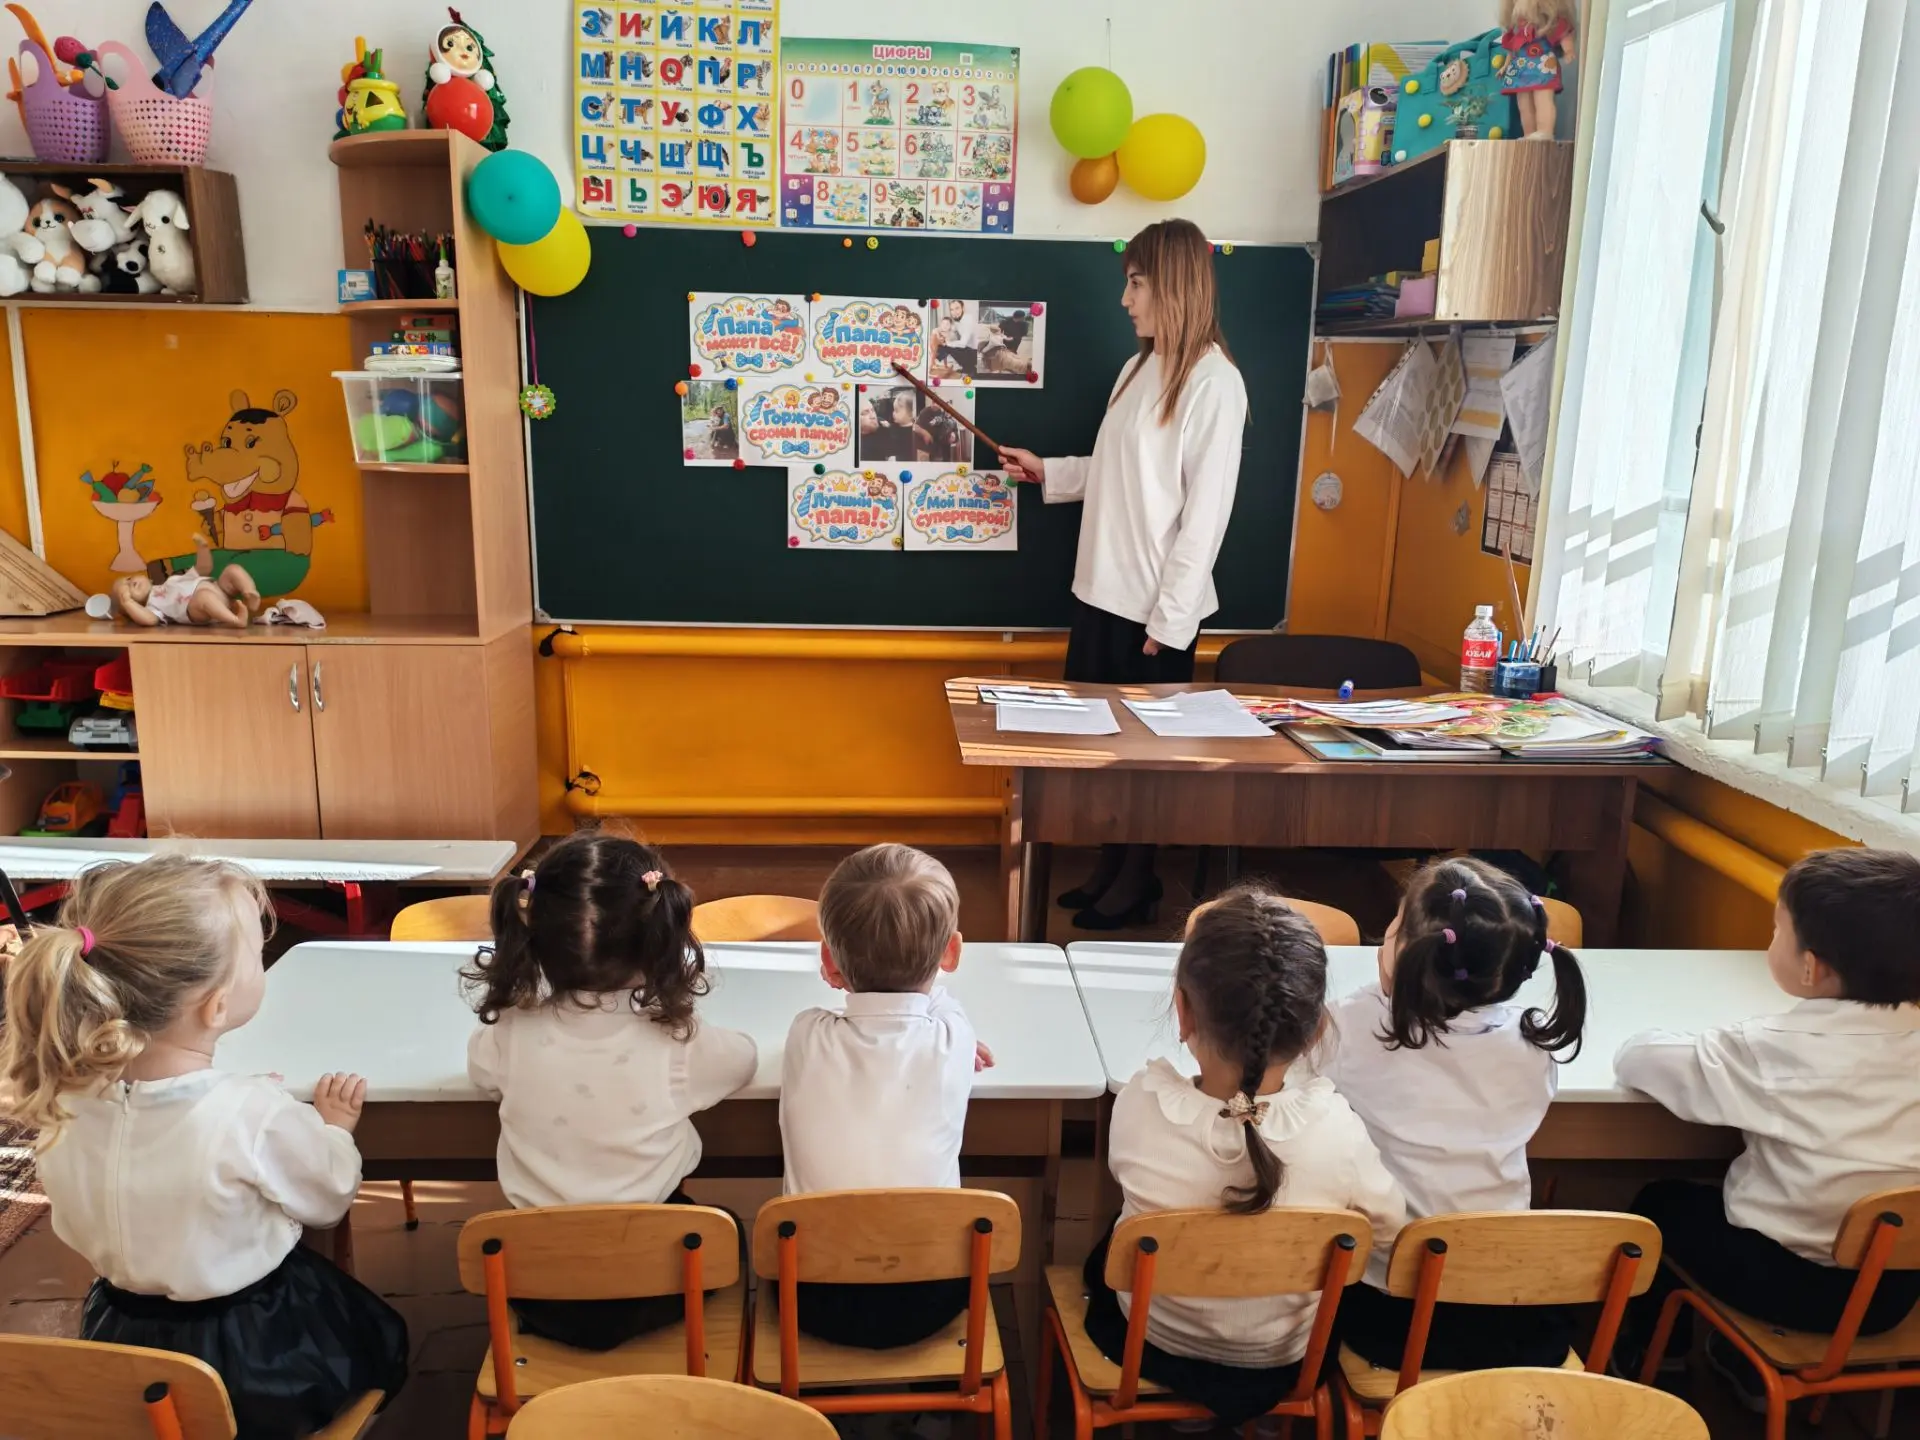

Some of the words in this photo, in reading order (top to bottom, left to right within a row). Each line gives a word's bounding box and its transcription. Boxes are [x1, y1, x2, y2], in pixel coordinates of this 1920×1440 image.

[581, 10, 601, 37] З
[620, 12, 642, 37] И
[661, 10, 683, 41] Й
[698, 17, 719, 42] К
[737, 20, 760, 46] Л
[873, 46, 930, 60] ЦИФРЫ
[581, 53, 605, 78] М
[620, 55, 642, 81] Н
[660, 57, 683, 83] О
[698, 60, 720, 85] П
[737, 63, 757, 88] Р
[791, 79, 804, 99] 0
[848, 81, 858, 102] 1
[906, 83, 919, 104] 2
[963, 85, 975, 106] 3
[581, 96, 603, 120] С
[620, 98, 641, 123] Т
[661, 101, 681, 126] У
[698, 104, 724, 128] Ф
[736, 105, 759, 131] Х
[582, 135, 606, 164] Ц
[620, 139, 641, 165] Ч
[660, 143, 684, 167] Ш
[698, 142, 723, 171] Щ
[741, 142, 764, 167] Ъ
[790, 130, 804, 150] 4
[846, 132, 859, 152] 5
[905, 134, 917, 155] 6
[962, 136, 974, 156] 7
[583, 178, 612, 203] Ы
[630, 178, 647, 202] Ь
[661, 183, 683, 208] Э
[698, 185, 725, 211] Ю
[736, 188, 756, 213] Я
[817, 180, 829, 201] 8
[874, 182, 887, 203] 9
[932, 185, 957, 206] 10
[717, 316, 773, 336] Папа
[836, 325, 891, 344] Папа
[706, 337, 758, 351] может
[759, 332, 800, 353] всё!
[821, 344, 857, 358] моя
[860, 345, 920, 361] опора!
[763, 409, 834, 427] Горжусь
[749, 427, 797, 441] своим
[800, 427, 849, 443] папой!
[811, 492, 872, 509] Лучший
[926, 495, 955, 510] Мой
[958, 497, 991, 509] папа
[815, 505, 880, 527] папа!
[916, 510, 1010, 527] супергерой!
